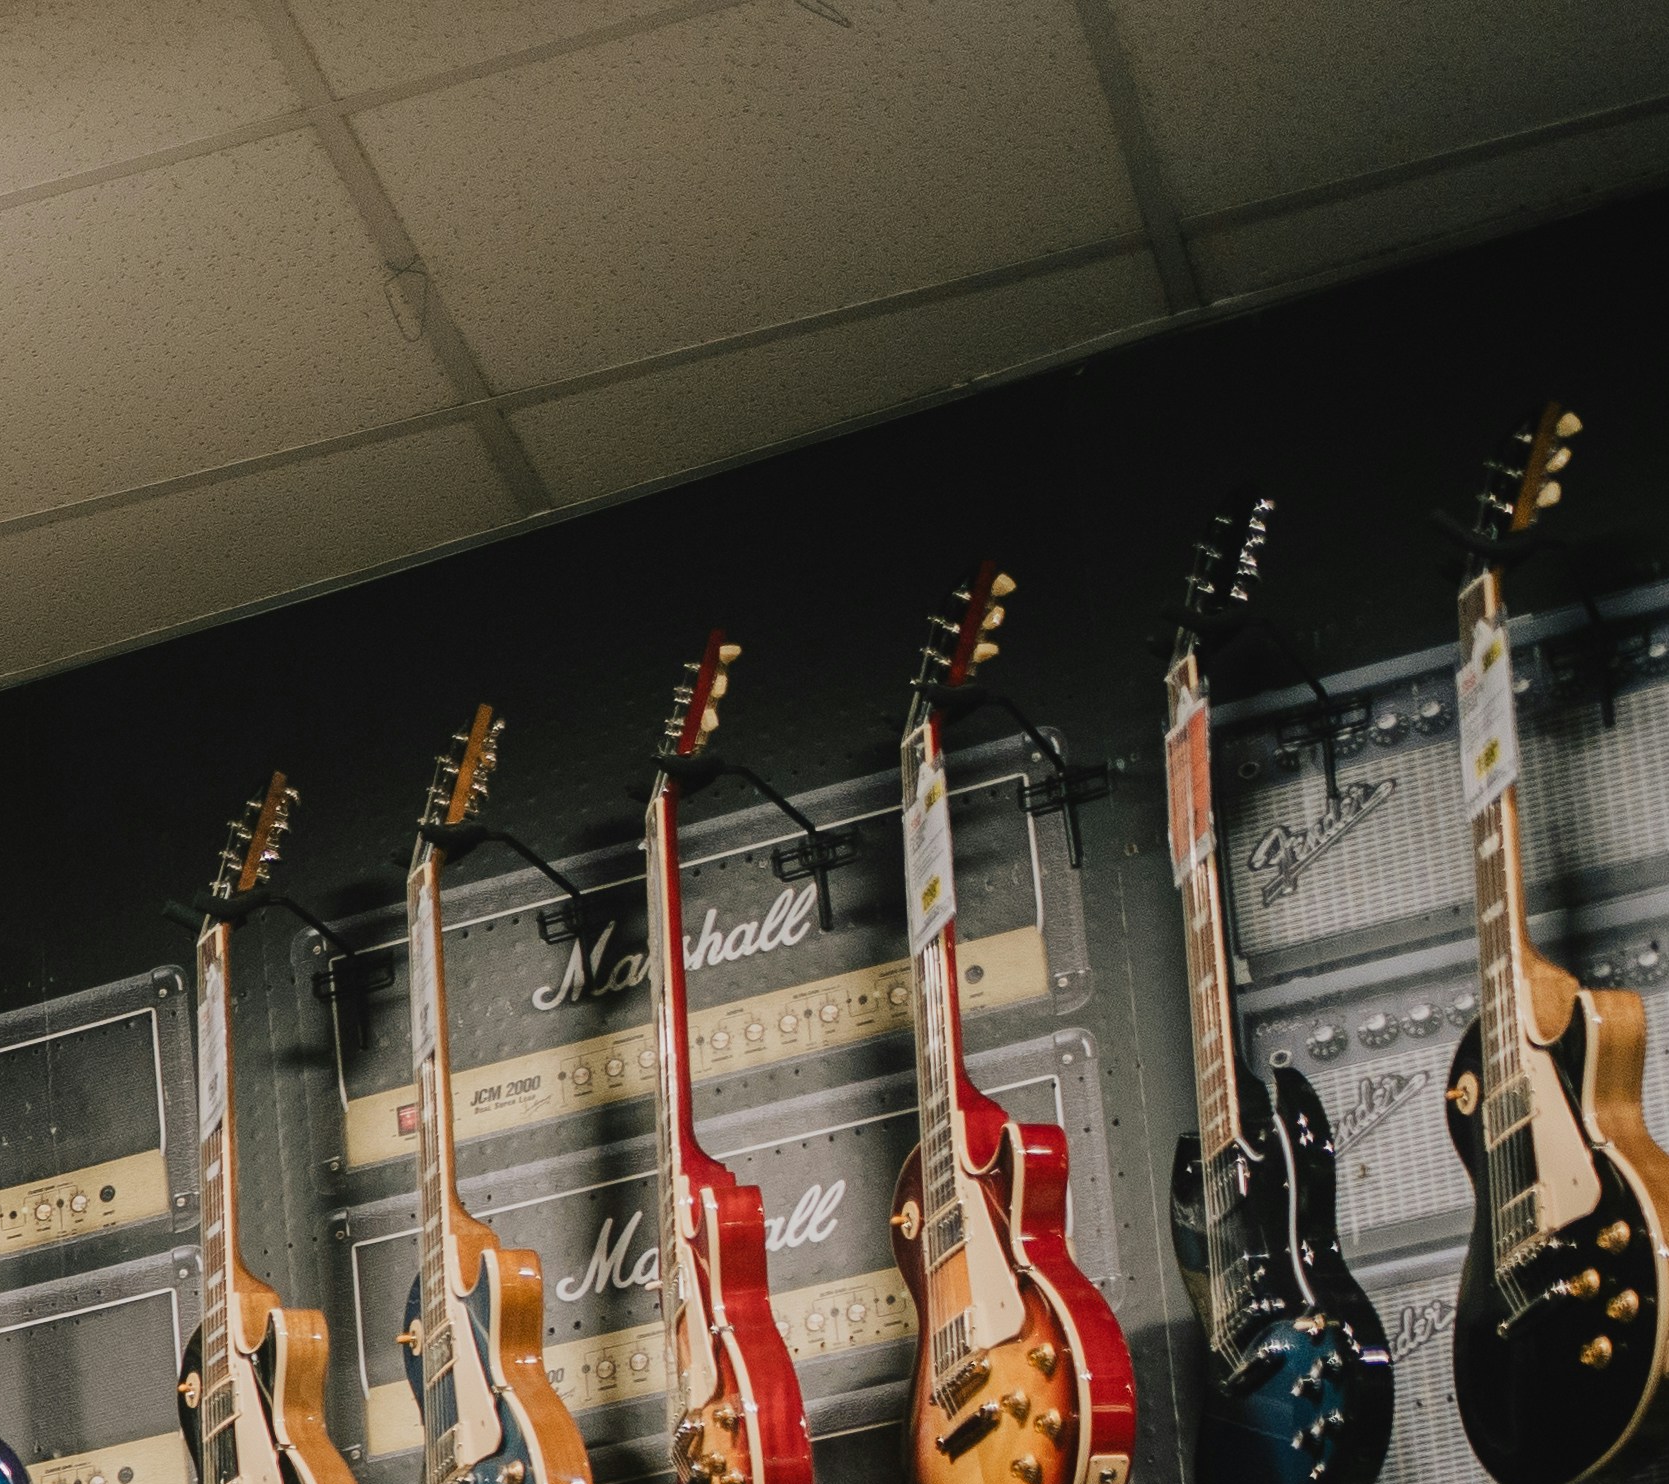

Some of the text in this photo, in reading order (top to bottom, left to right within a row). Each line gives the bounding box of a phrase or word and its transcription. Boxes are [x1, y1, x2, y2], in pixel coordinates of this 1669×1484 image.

[533, 883, 821, 1013] Mashall
[470, 1075, 541, 1106] JCM 2000
